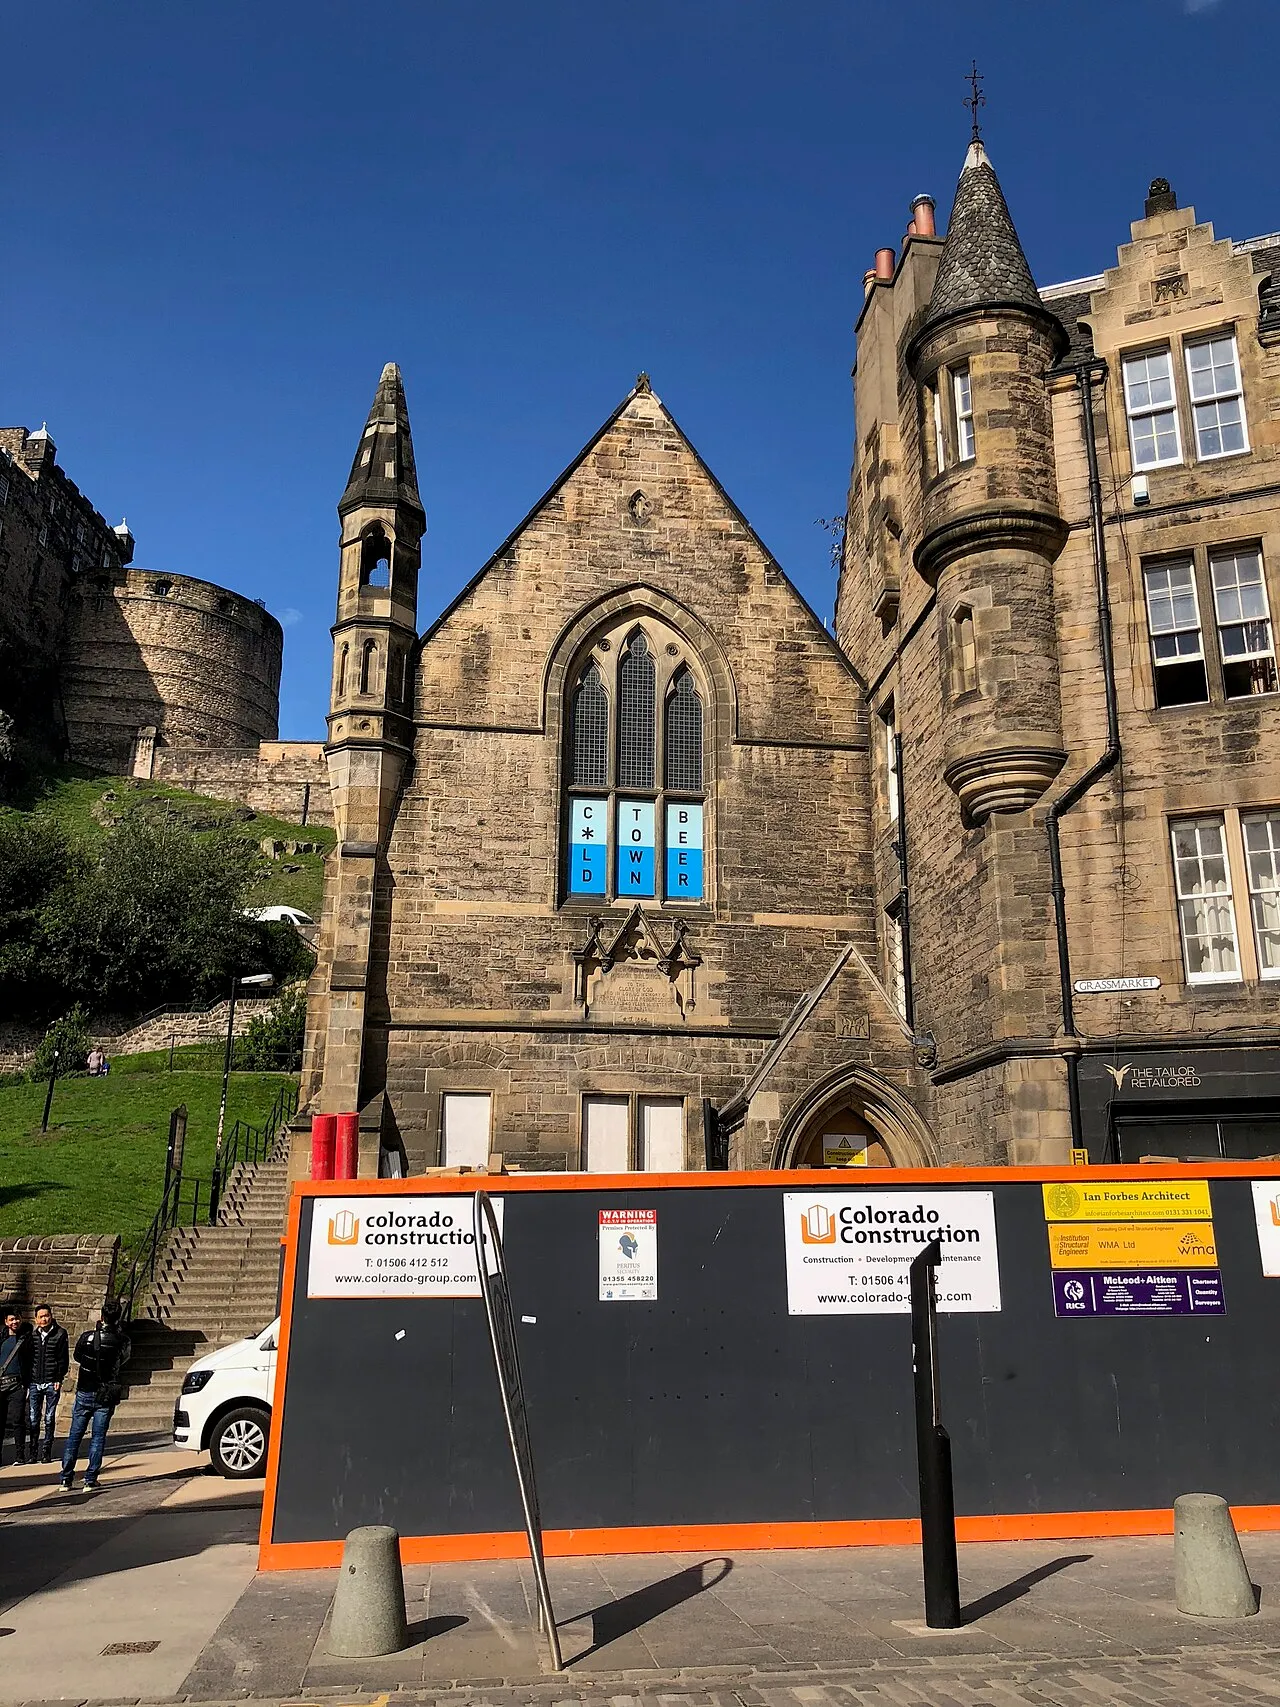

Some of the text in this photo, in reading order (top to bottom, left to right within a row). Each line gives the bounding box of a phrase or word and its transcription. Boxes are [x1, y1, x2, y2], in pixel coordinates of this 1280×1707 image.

[629, 808, 643, 884] TOWN
[678, 811, 689, 886] BEER
[1079, 978, 1155, 991] GRASSMARKET
[1131, 1066, 1196, 1077] THE TAILOR
[1131, 1076, 1201, 1088] RETAILORED
[1083, 1191, 1190, 1201] Ian Forbes Architect
[366, 1211, 453, 1228] colorado
[602, 1211, 654, 1219] WARNING
[839, 1205, 939, 1224] Colorado
[840, 1225, 980, 1244] Construction
[1059, 1241, 1089, 1249] Structural
[1098, 1241, 1136, 1249] WMA Ltd
[1177, 1245, 1215, 1255] wma
[1058, 1248, 1089, 1256] Engineers
[365, 1258, 448, 1268] T: 01506 412 512
[803, 1256, 854, 1264] Construction
[866, 1255, 917, 1264] Developmen
[335, 1273, 477, 1285] www.colorado-group.com
[848, 1275, 909, 1286] T: 01506 41
[817, 1291, 972, 1305] www.colorado-gp.com
[1065, 1302, 1086, 1310] RICS
